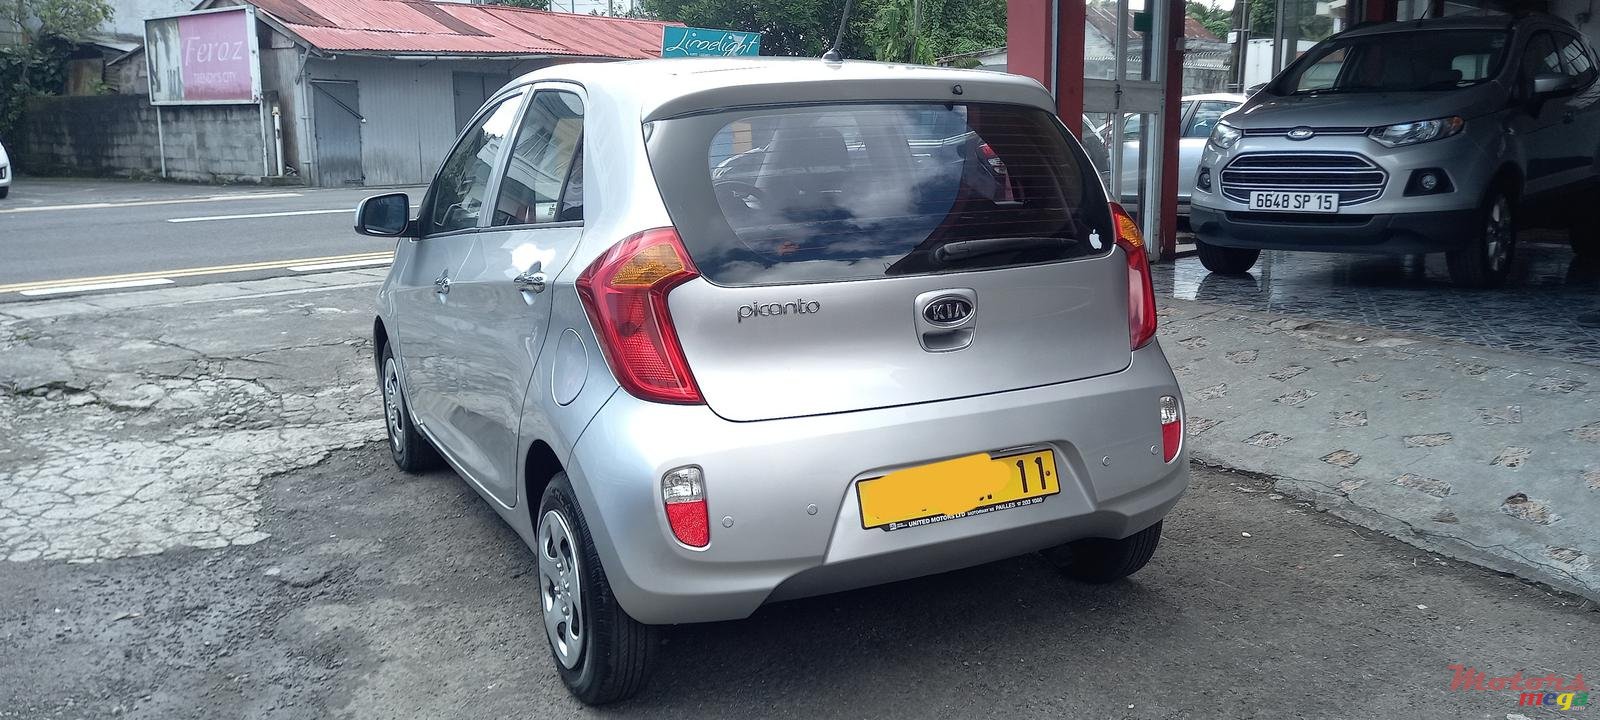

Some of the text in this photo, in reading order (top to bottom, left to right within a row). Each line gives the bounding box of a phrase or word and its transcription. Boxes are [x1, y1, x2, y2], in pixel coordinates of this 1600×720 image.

[184, 36, 243, 67] Feroz
[665, 29, 759, 57] Limelight
[1256, 193, 1333, 210] 6648 SP 15
[736, 297, 821, 323] picanto
[932, 303, 967, 321] KIA
[1016, 456, 1047, 493] 11
[908, 517, 931, 528] UNITED
